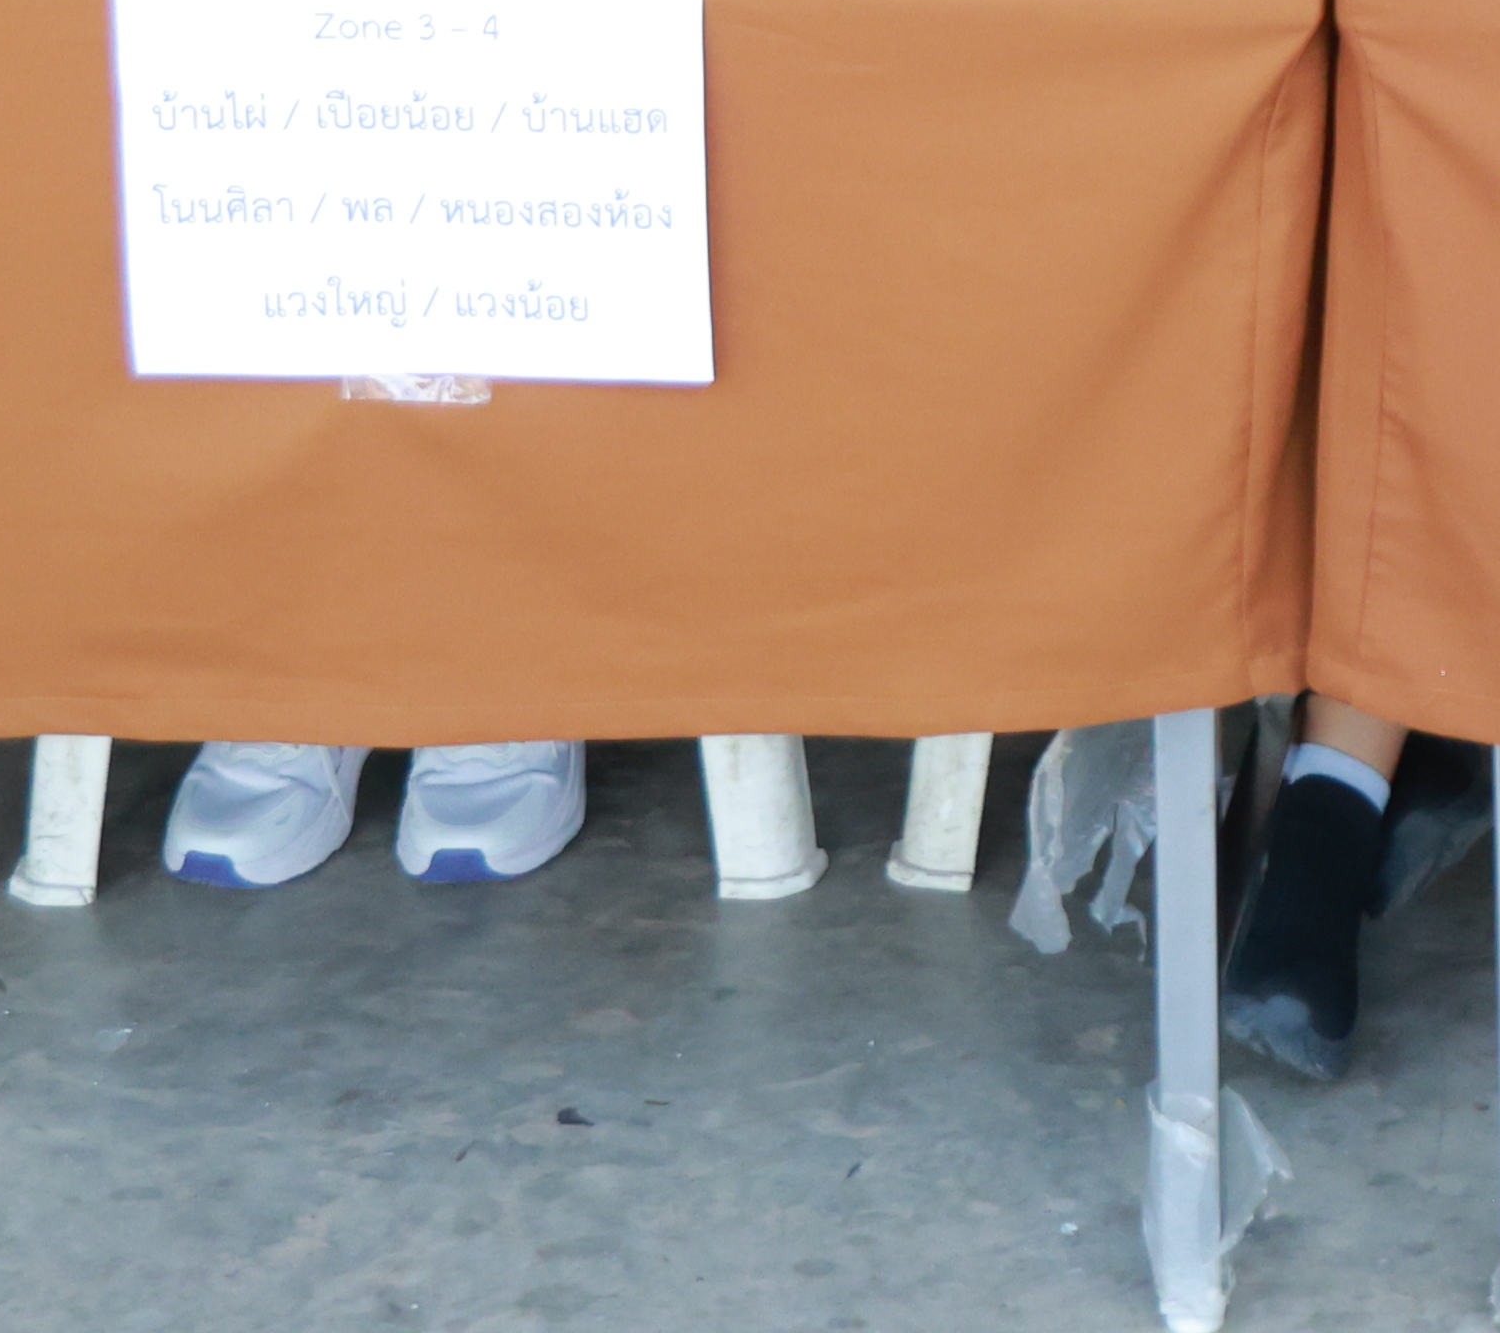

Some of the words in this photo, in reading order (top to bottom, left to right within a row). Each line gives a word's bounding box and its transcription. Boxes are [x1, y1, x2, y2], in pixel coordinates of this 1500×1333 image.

[313, 11, 403, 42] Zone
[419, 13, 436, 42] 3
[482, 13, 500, 40] 4
[151, 89, 268, 132] บ้านไผ่
[521, 91, 668, 136] บ้านแฮด
[151, 182, 294, 225] โนนศิลา
[341, 196, 394, 223] พล
[439, 188, 673, 231] หนองสองห้อง
[263, 275, 407, 330] แวงใหญ่
[455, 279, 590, 323] แวงน้อย
